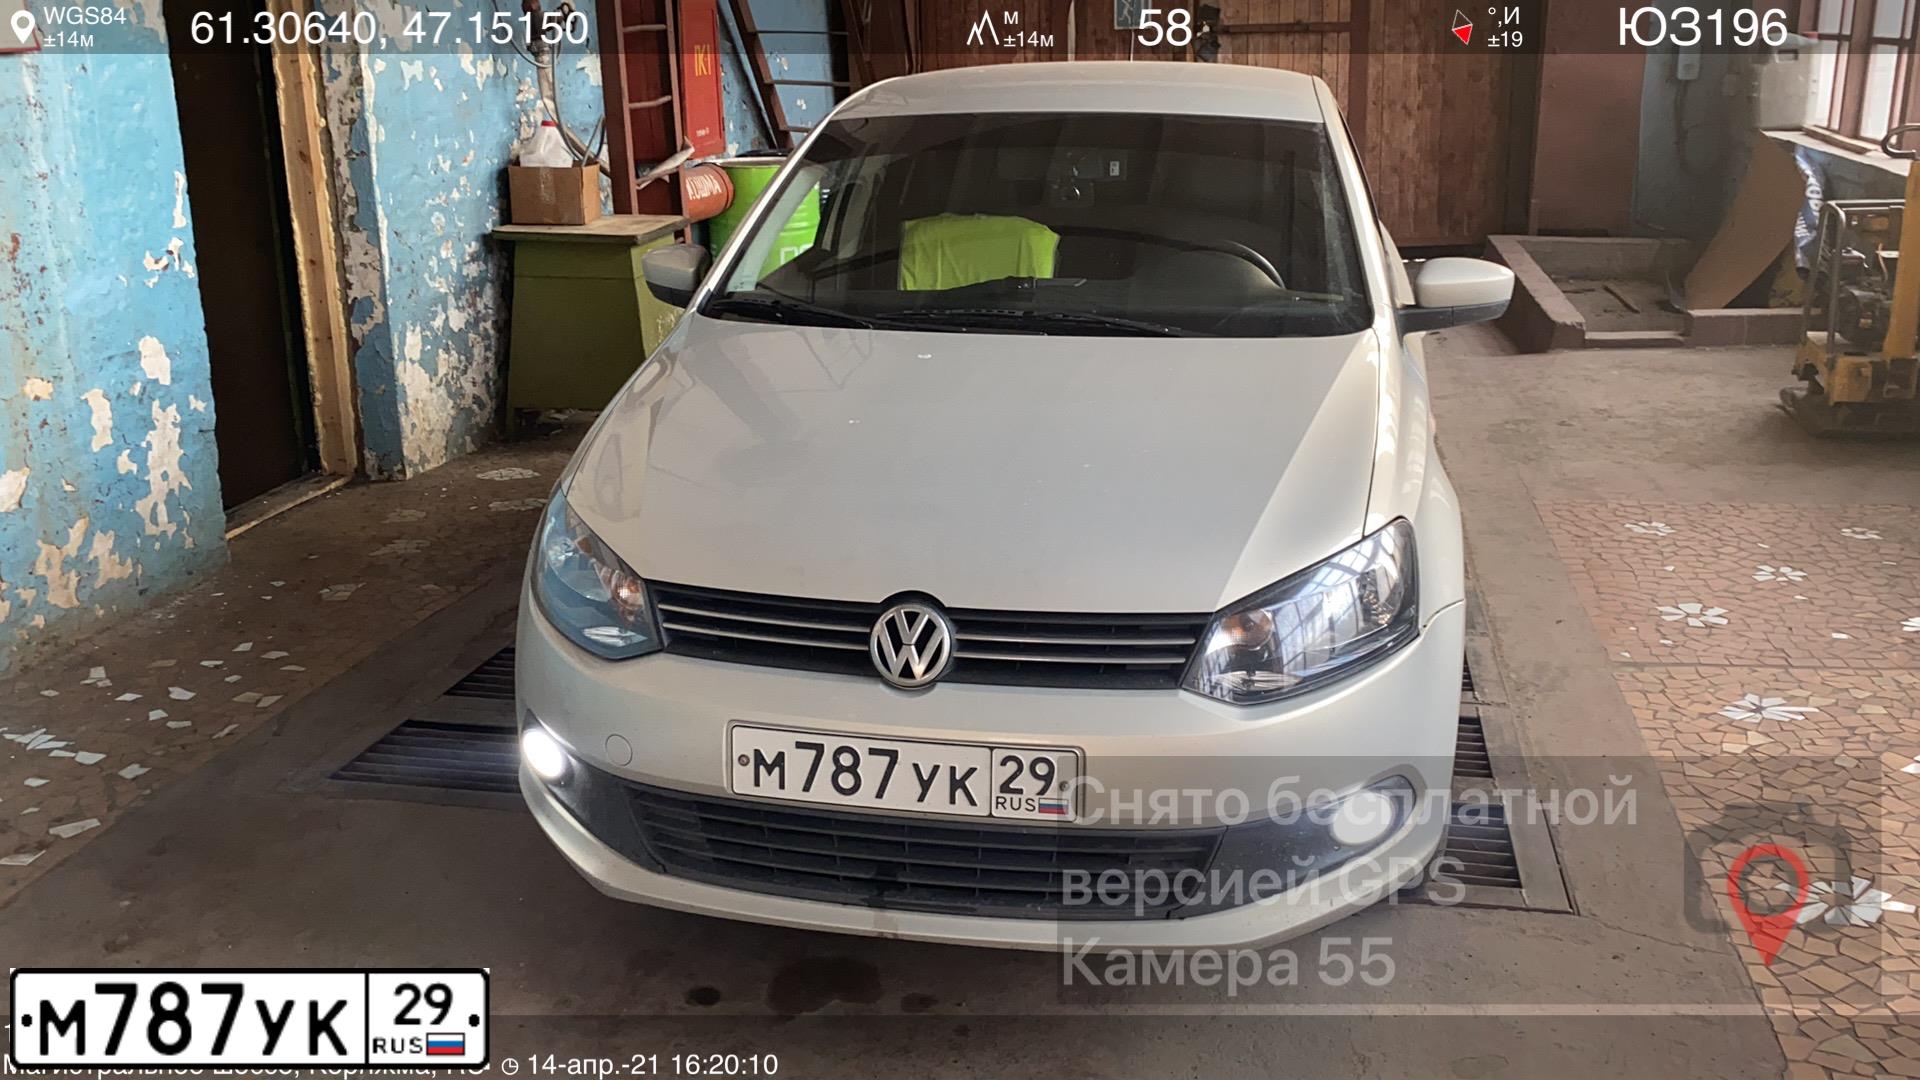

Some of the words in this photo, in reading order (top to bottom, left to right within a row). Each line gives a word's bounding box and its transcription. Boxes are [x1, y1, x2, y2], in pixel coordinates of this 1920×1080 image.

[753, 740, 979, 808] М787УК
[998, 754, 1057, 797] 29
[995, 796, 1037, 812] RUS
